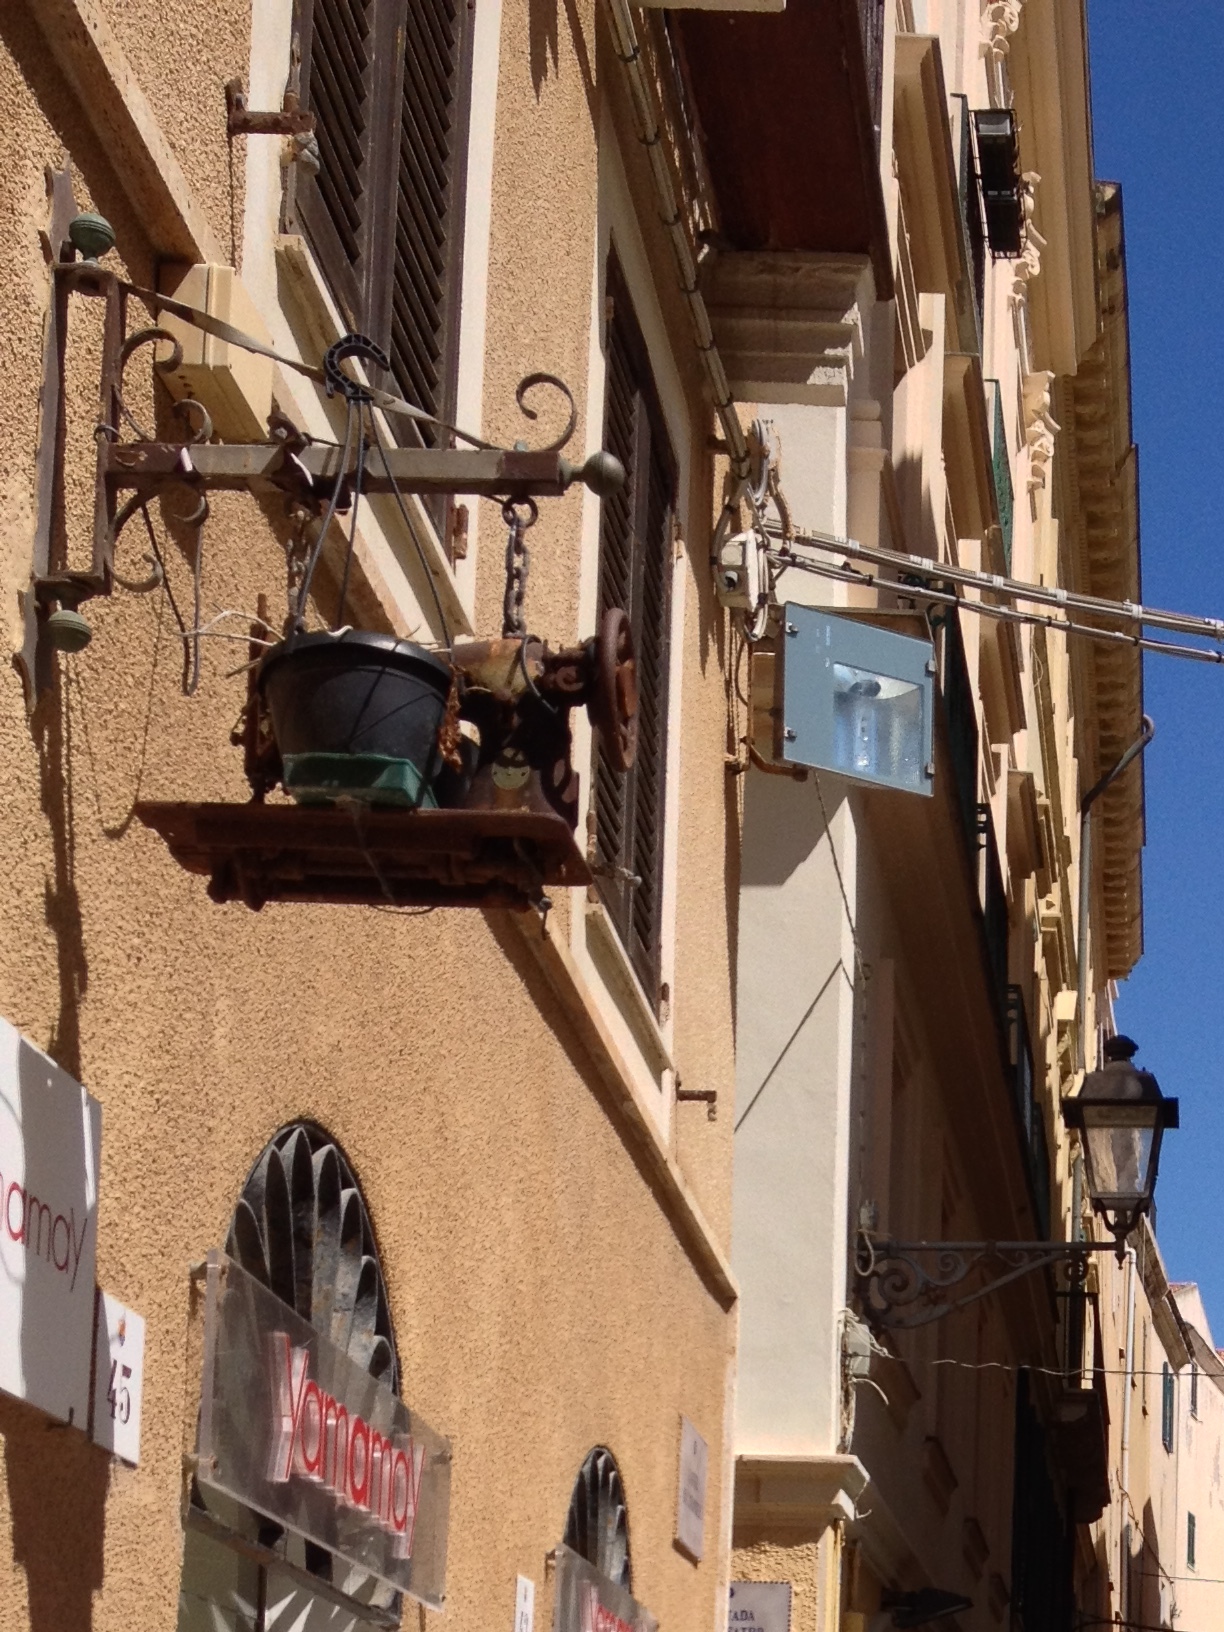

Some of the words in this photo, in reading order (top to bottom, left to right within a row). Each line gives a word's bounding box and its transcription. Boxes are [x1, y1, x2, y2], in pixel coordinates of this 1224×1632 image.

[0, 1171, 88, 1293] amay
[107, 1358, 133, 1425] 45
[272, 1331, 427, 1560] Yamamay
